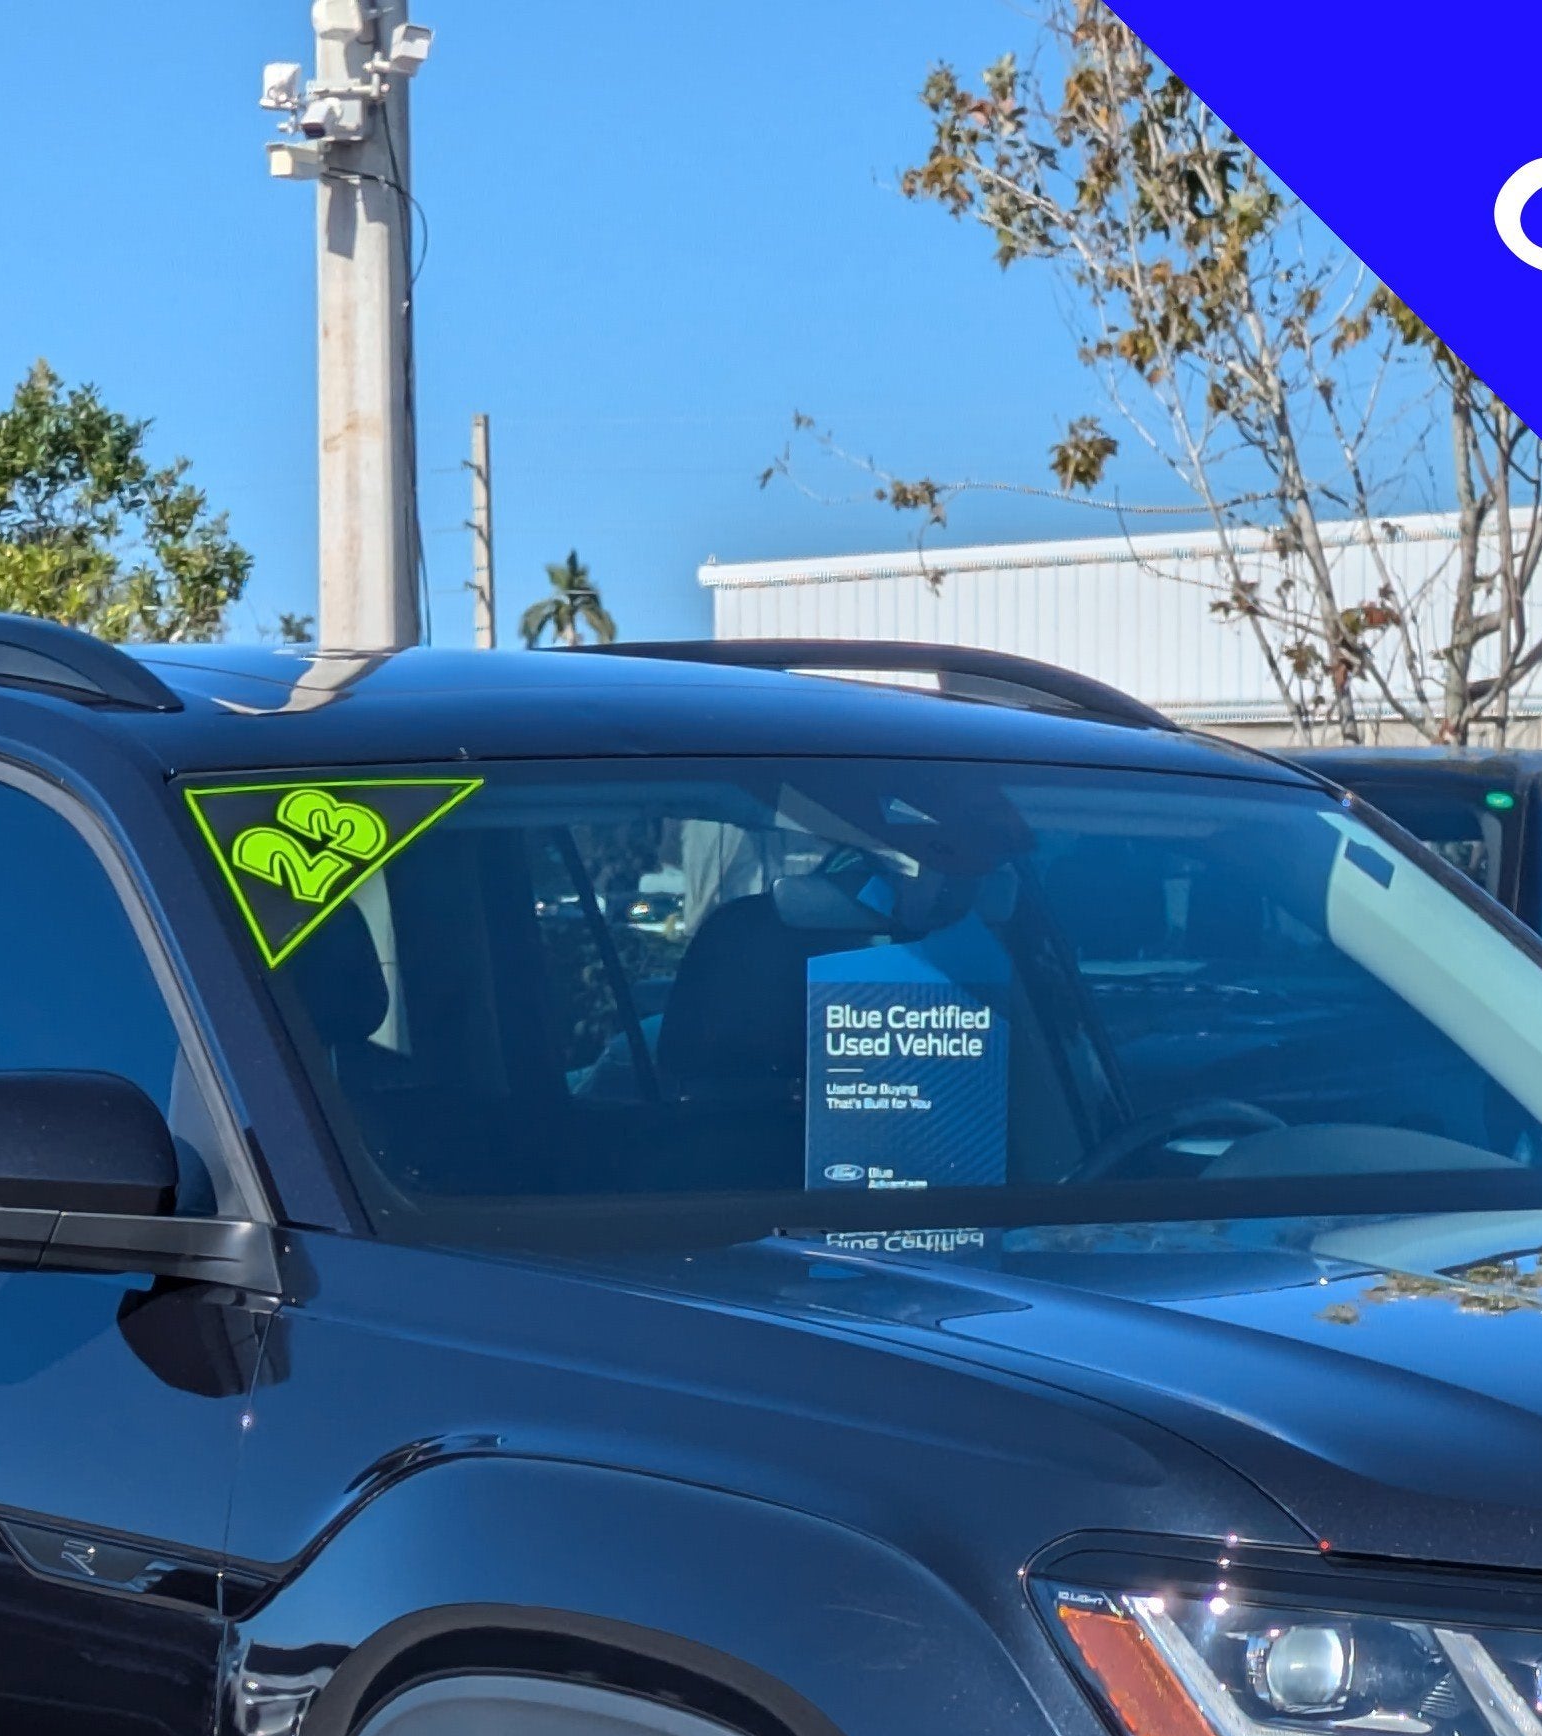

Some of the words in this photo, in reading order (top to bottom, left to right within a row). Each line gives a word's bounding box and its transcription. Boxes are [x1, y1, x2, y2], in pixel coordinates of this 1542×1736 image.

[232, 789, 388, 904] 23
[826, 1004, 883, 1029] Blue
[887, 1004, 992, 1029] Certified
[826, 1033, 891, 1057] Used
[896, 1033, 984, 1057] Vehicle
[826, 1083, 856, 1095] Used
[858, 1083, 878, 1095] Car
[880, 1083, 918, 1097] Buying
[826, 1098, 862, 1109] That's
[891, 1098, 908, 1109] for
